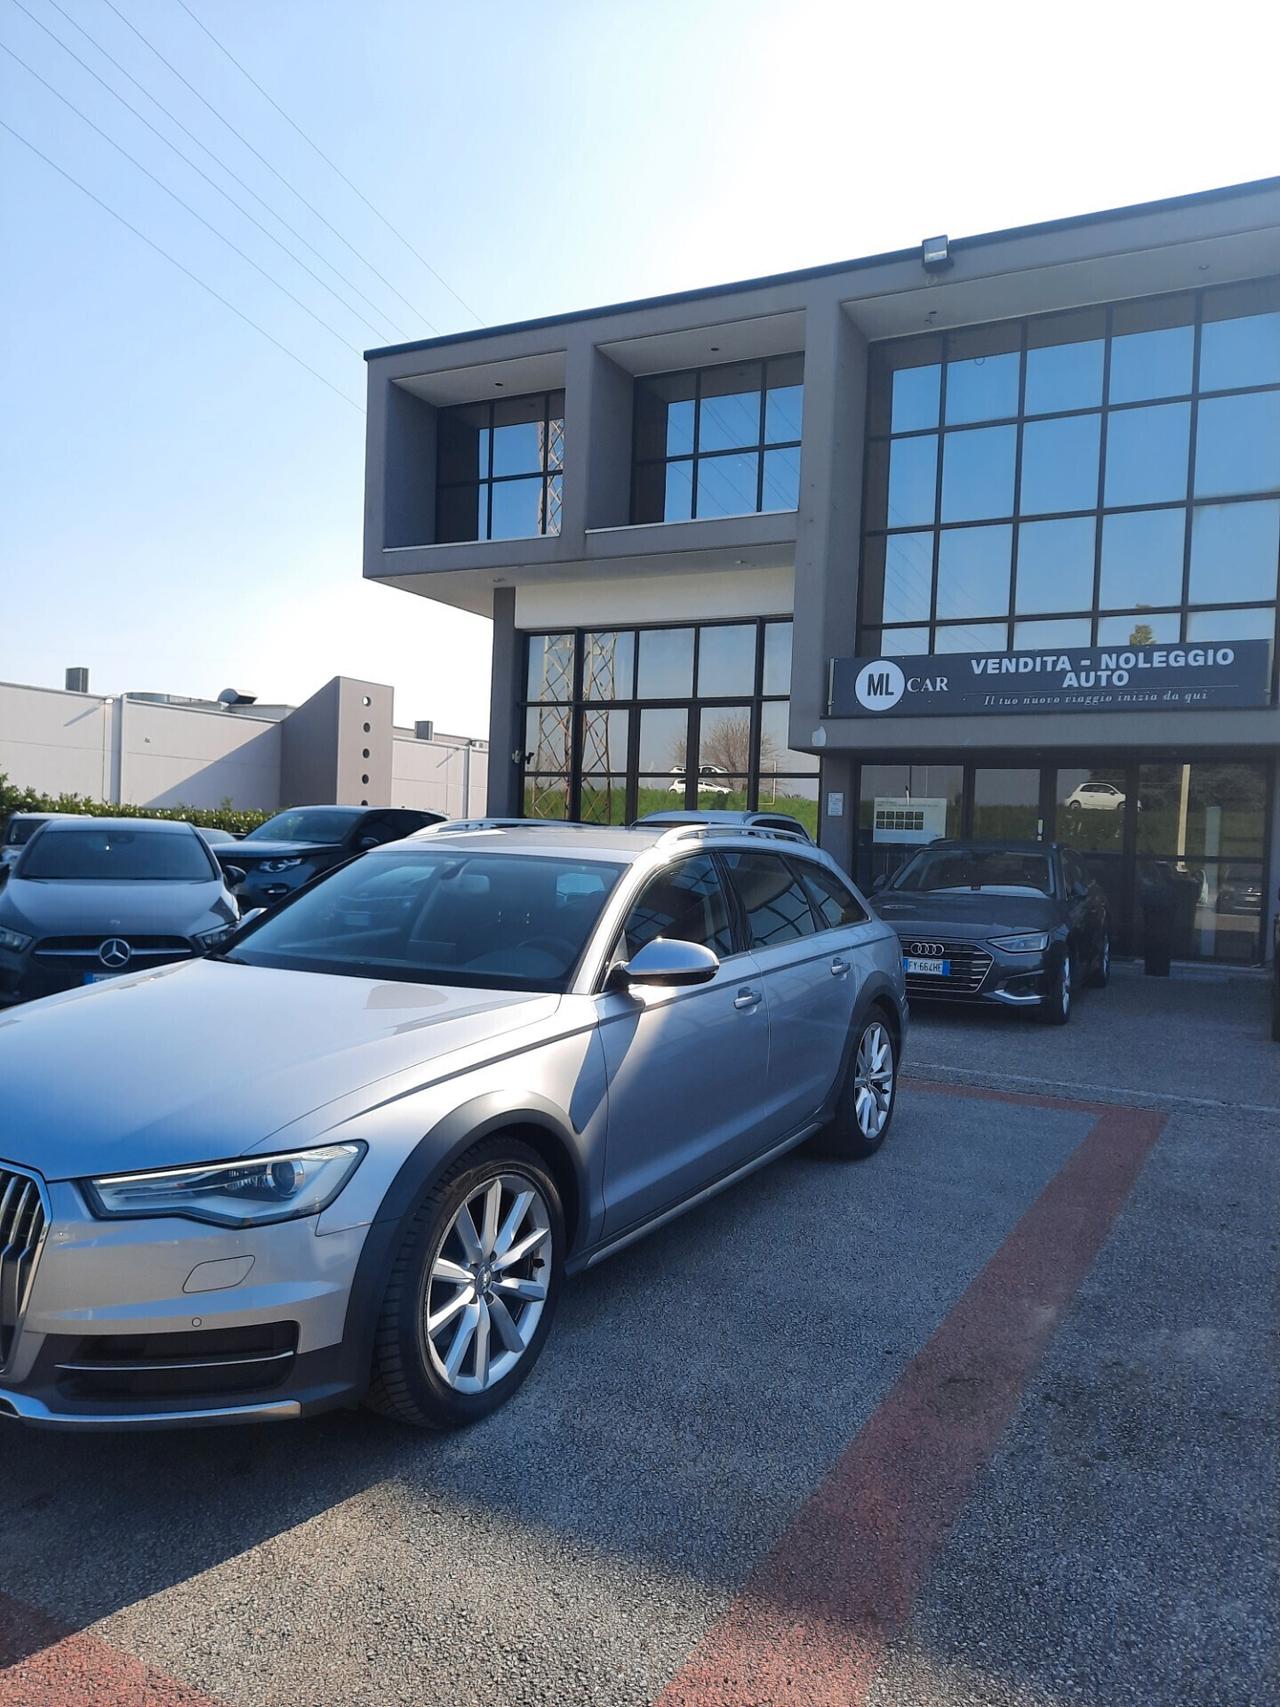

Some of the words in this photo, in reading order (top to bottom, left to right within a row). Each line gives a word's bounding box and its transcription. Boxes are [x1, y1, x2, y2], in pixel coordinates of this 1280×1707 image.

[971, 655, 1072, 675] VENDITA
[1101, 648, 1235, 670] NOLEGGIO
[867, 673, 895, 697] ML
[906, 676, 949, 693] CAR
[1062, 670, 1130, 688] AUTO
[999, 696, 1018, 705] tuo
[1023, 695, 1060, 705] nuovo
[1065, 692, 1113, 706] viaggio
[1118, 691, 1158, 702] inizia
[1163, 690, 1179, 701] da
[1185, 689, 1208, 703] qui
